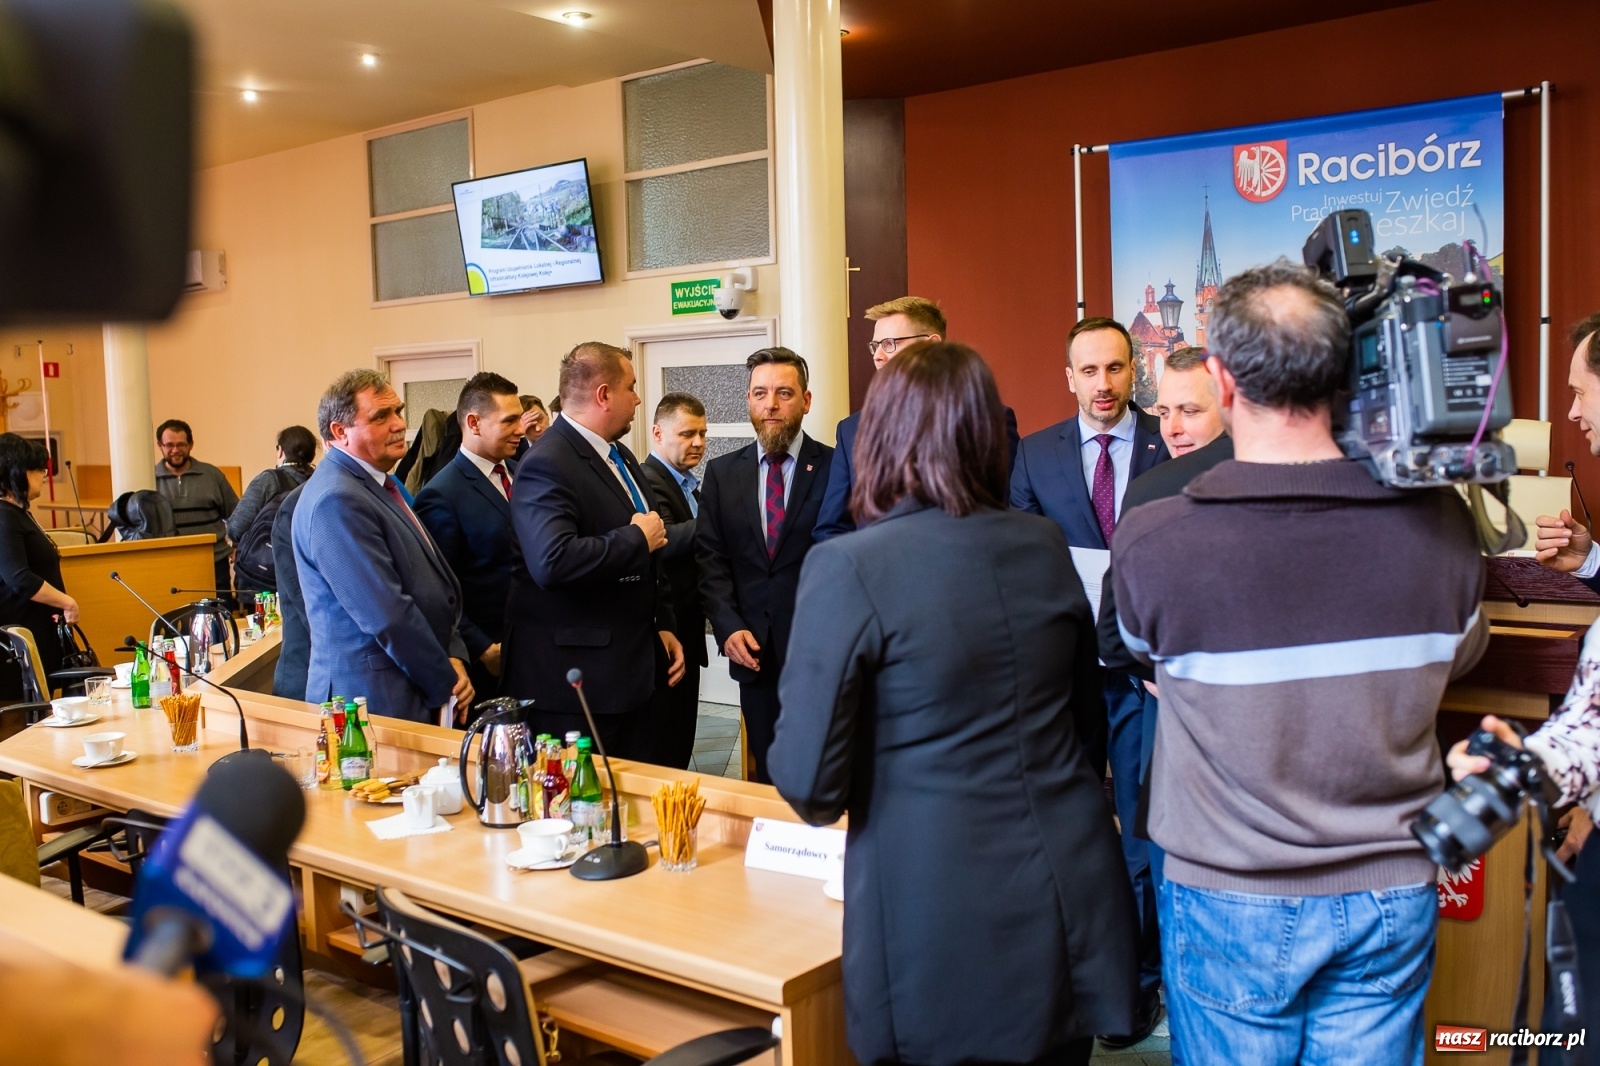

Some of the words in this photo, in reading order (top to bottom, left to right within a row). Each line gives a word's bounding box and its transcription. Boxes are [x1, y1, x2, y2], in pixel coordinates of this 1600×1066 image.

[1298, 133, 1482, 186] Racibórz
[1324, 188, 1383, 207] Inwestuj
[1386, 183, 1474, 213] Zwiedź
[555, 258, 582, 266] Regionalnej
[675, 284, 718, 298] WYJŚCIE
[673, 298, 715, 310] EWAKUACYJN
[765, 842, 828, 860] Samorządowcy
